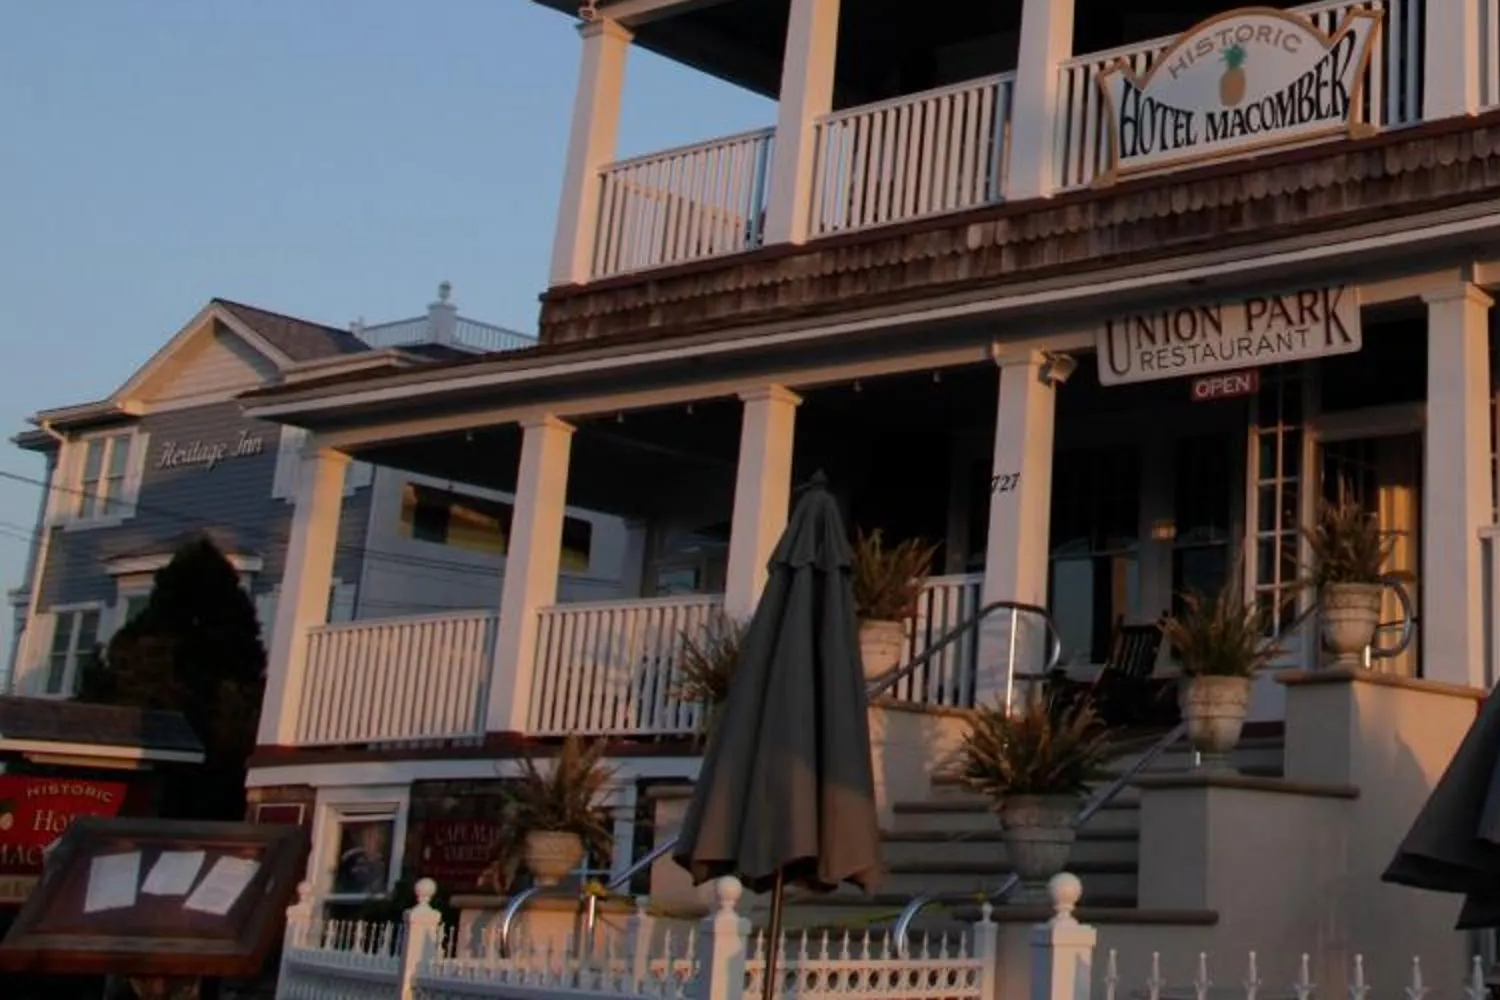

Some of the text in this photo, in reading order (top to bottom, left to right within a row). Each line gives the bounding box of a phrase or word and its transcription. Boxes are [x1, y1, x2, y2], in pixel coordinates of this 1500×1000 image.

[1166, 24, 1302, 80] HISTORIC
[1119, 28, 1357, 159] HOTEL MACOMBER
[1105, 283, 1352, 377] UNION PARK
[1139, 328, 1311, 372] RESTAURANT
[1195, 375, 1251, 398] OPEN
[158, 431, 263, 471] Heritage Inn
[991, 471, 1021, 493] 727
[26, 781, 114, 804] HISTORIC
